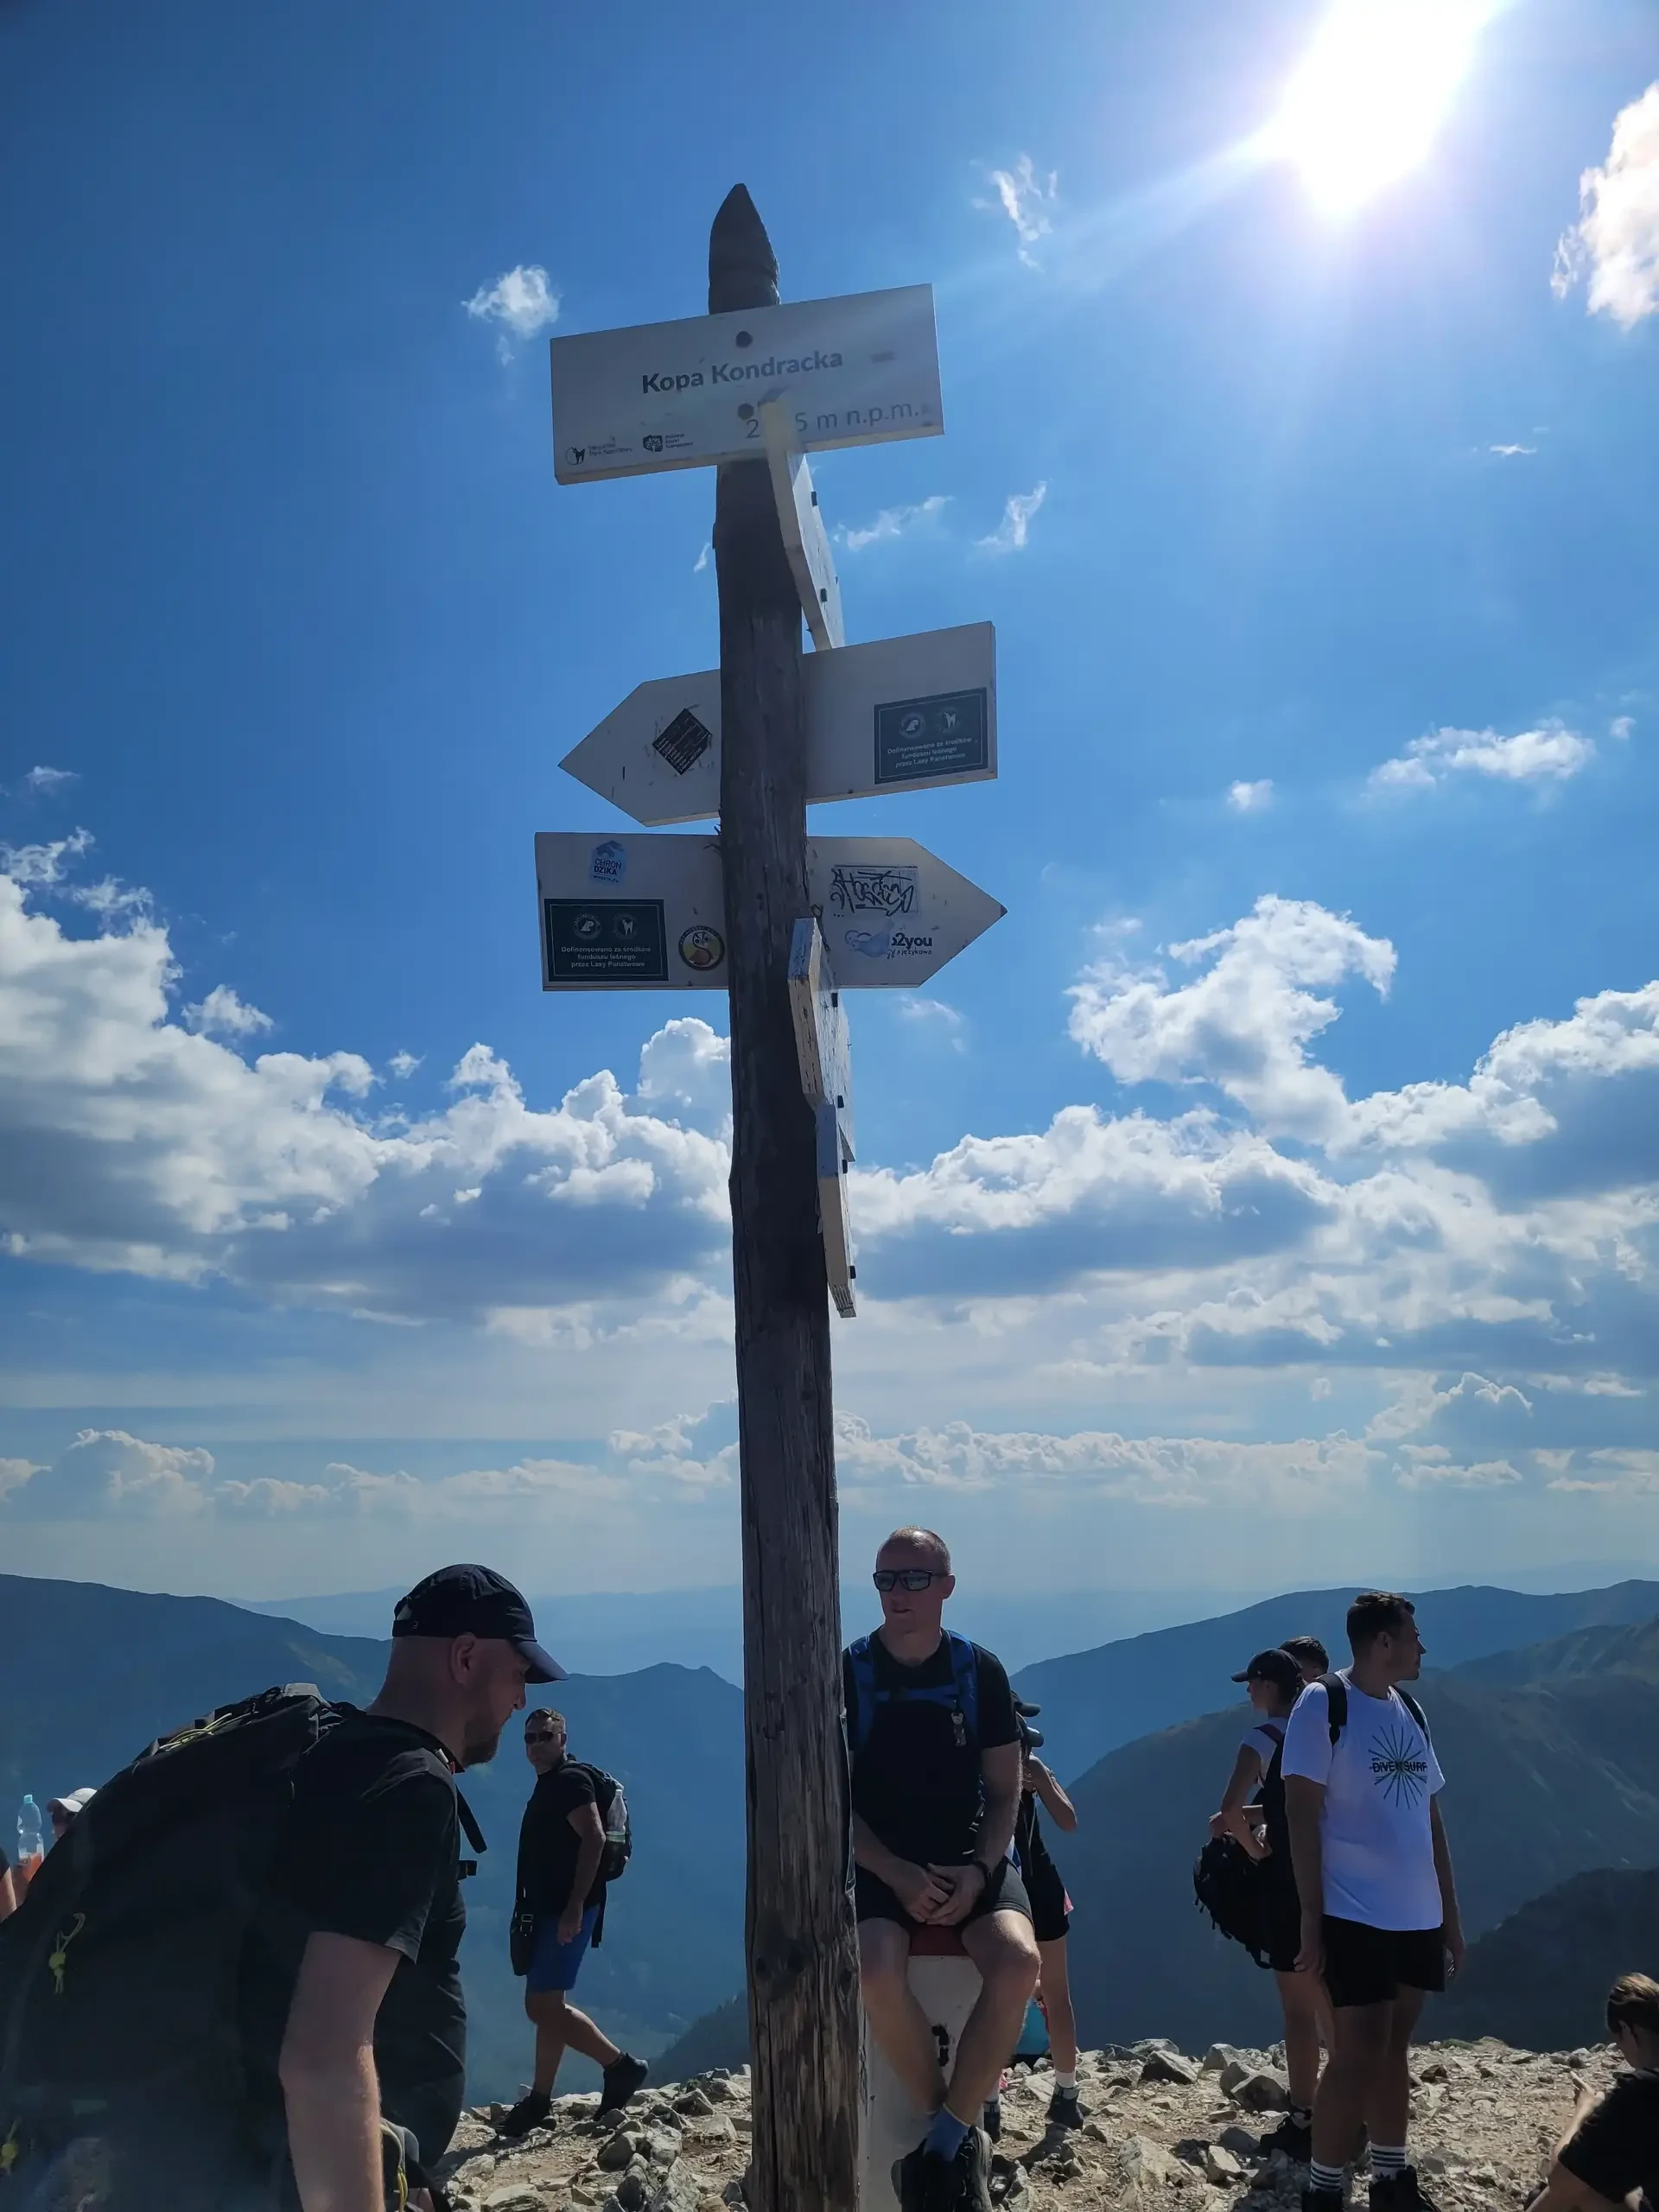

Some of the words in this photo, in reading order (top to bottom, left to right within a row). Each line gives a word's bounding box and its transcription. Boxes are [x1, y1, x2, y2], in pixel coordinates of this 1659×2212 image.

[642, 368, 704, 394] Kopa
[712, 350, 843, 384] Kondracka
[745, 412, 808, 439] 25
[817, 413, 838, 430] m
[847, 403, 919, 427] n.p.m.
[594, 865, 618, 876] DZIKA
